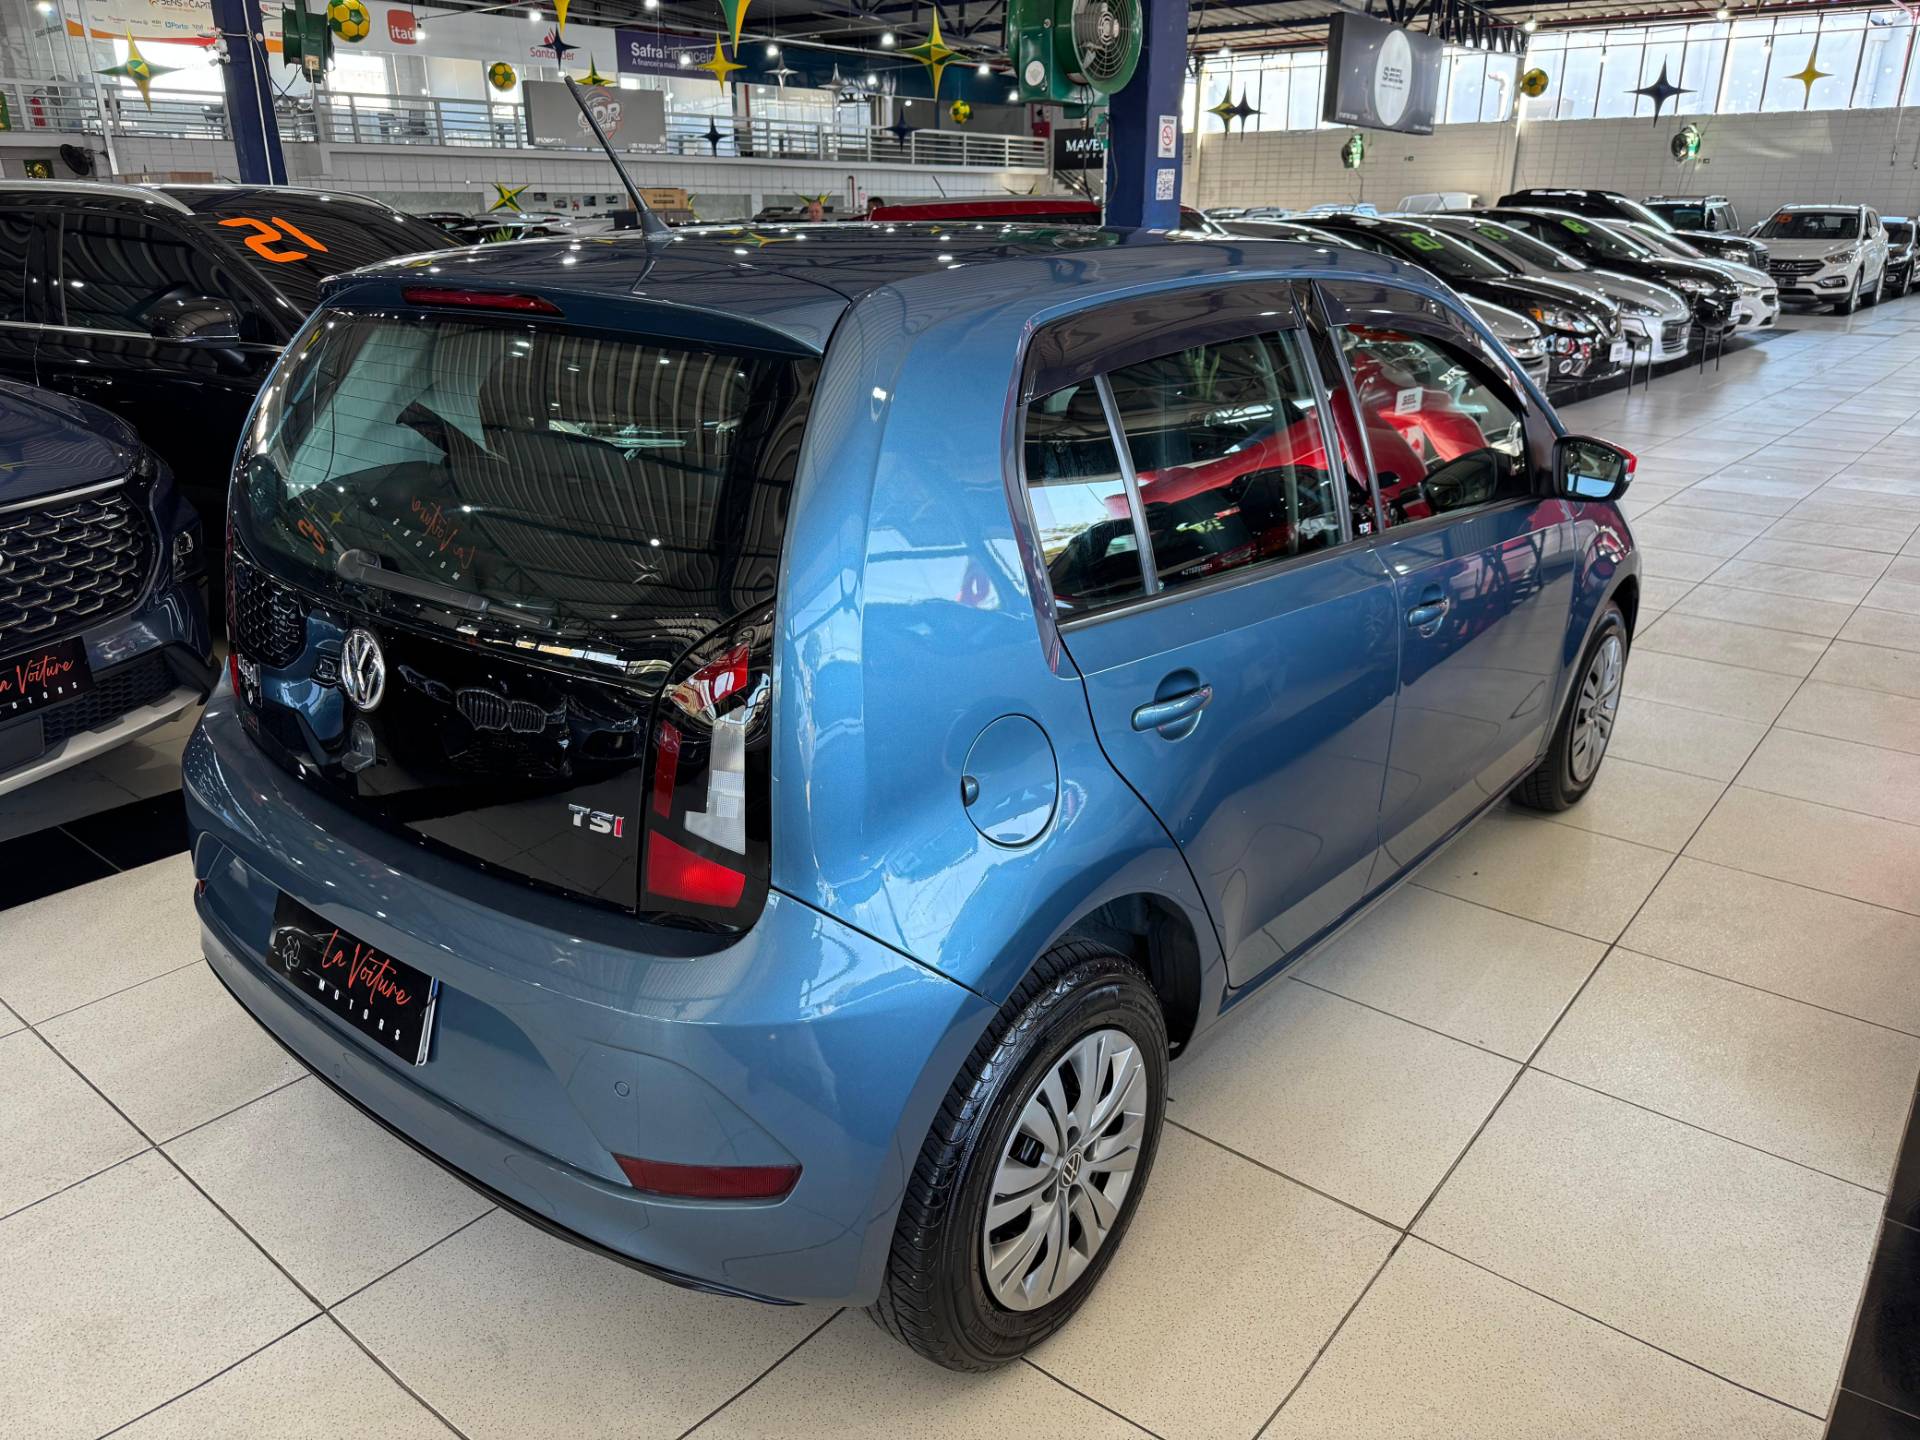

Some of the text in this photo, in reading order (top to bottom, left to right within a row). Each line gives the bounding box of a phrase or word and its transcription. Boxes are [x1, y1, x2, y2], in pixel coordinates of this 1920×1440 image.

[530, 46, 575, 61] Santader
[217, 216, 329, 263] 21
[16, 655, 74, 695] Voiture
[0, 681, 78, 715] OTORS
[321, 928, 412, 1006] La Voiture
